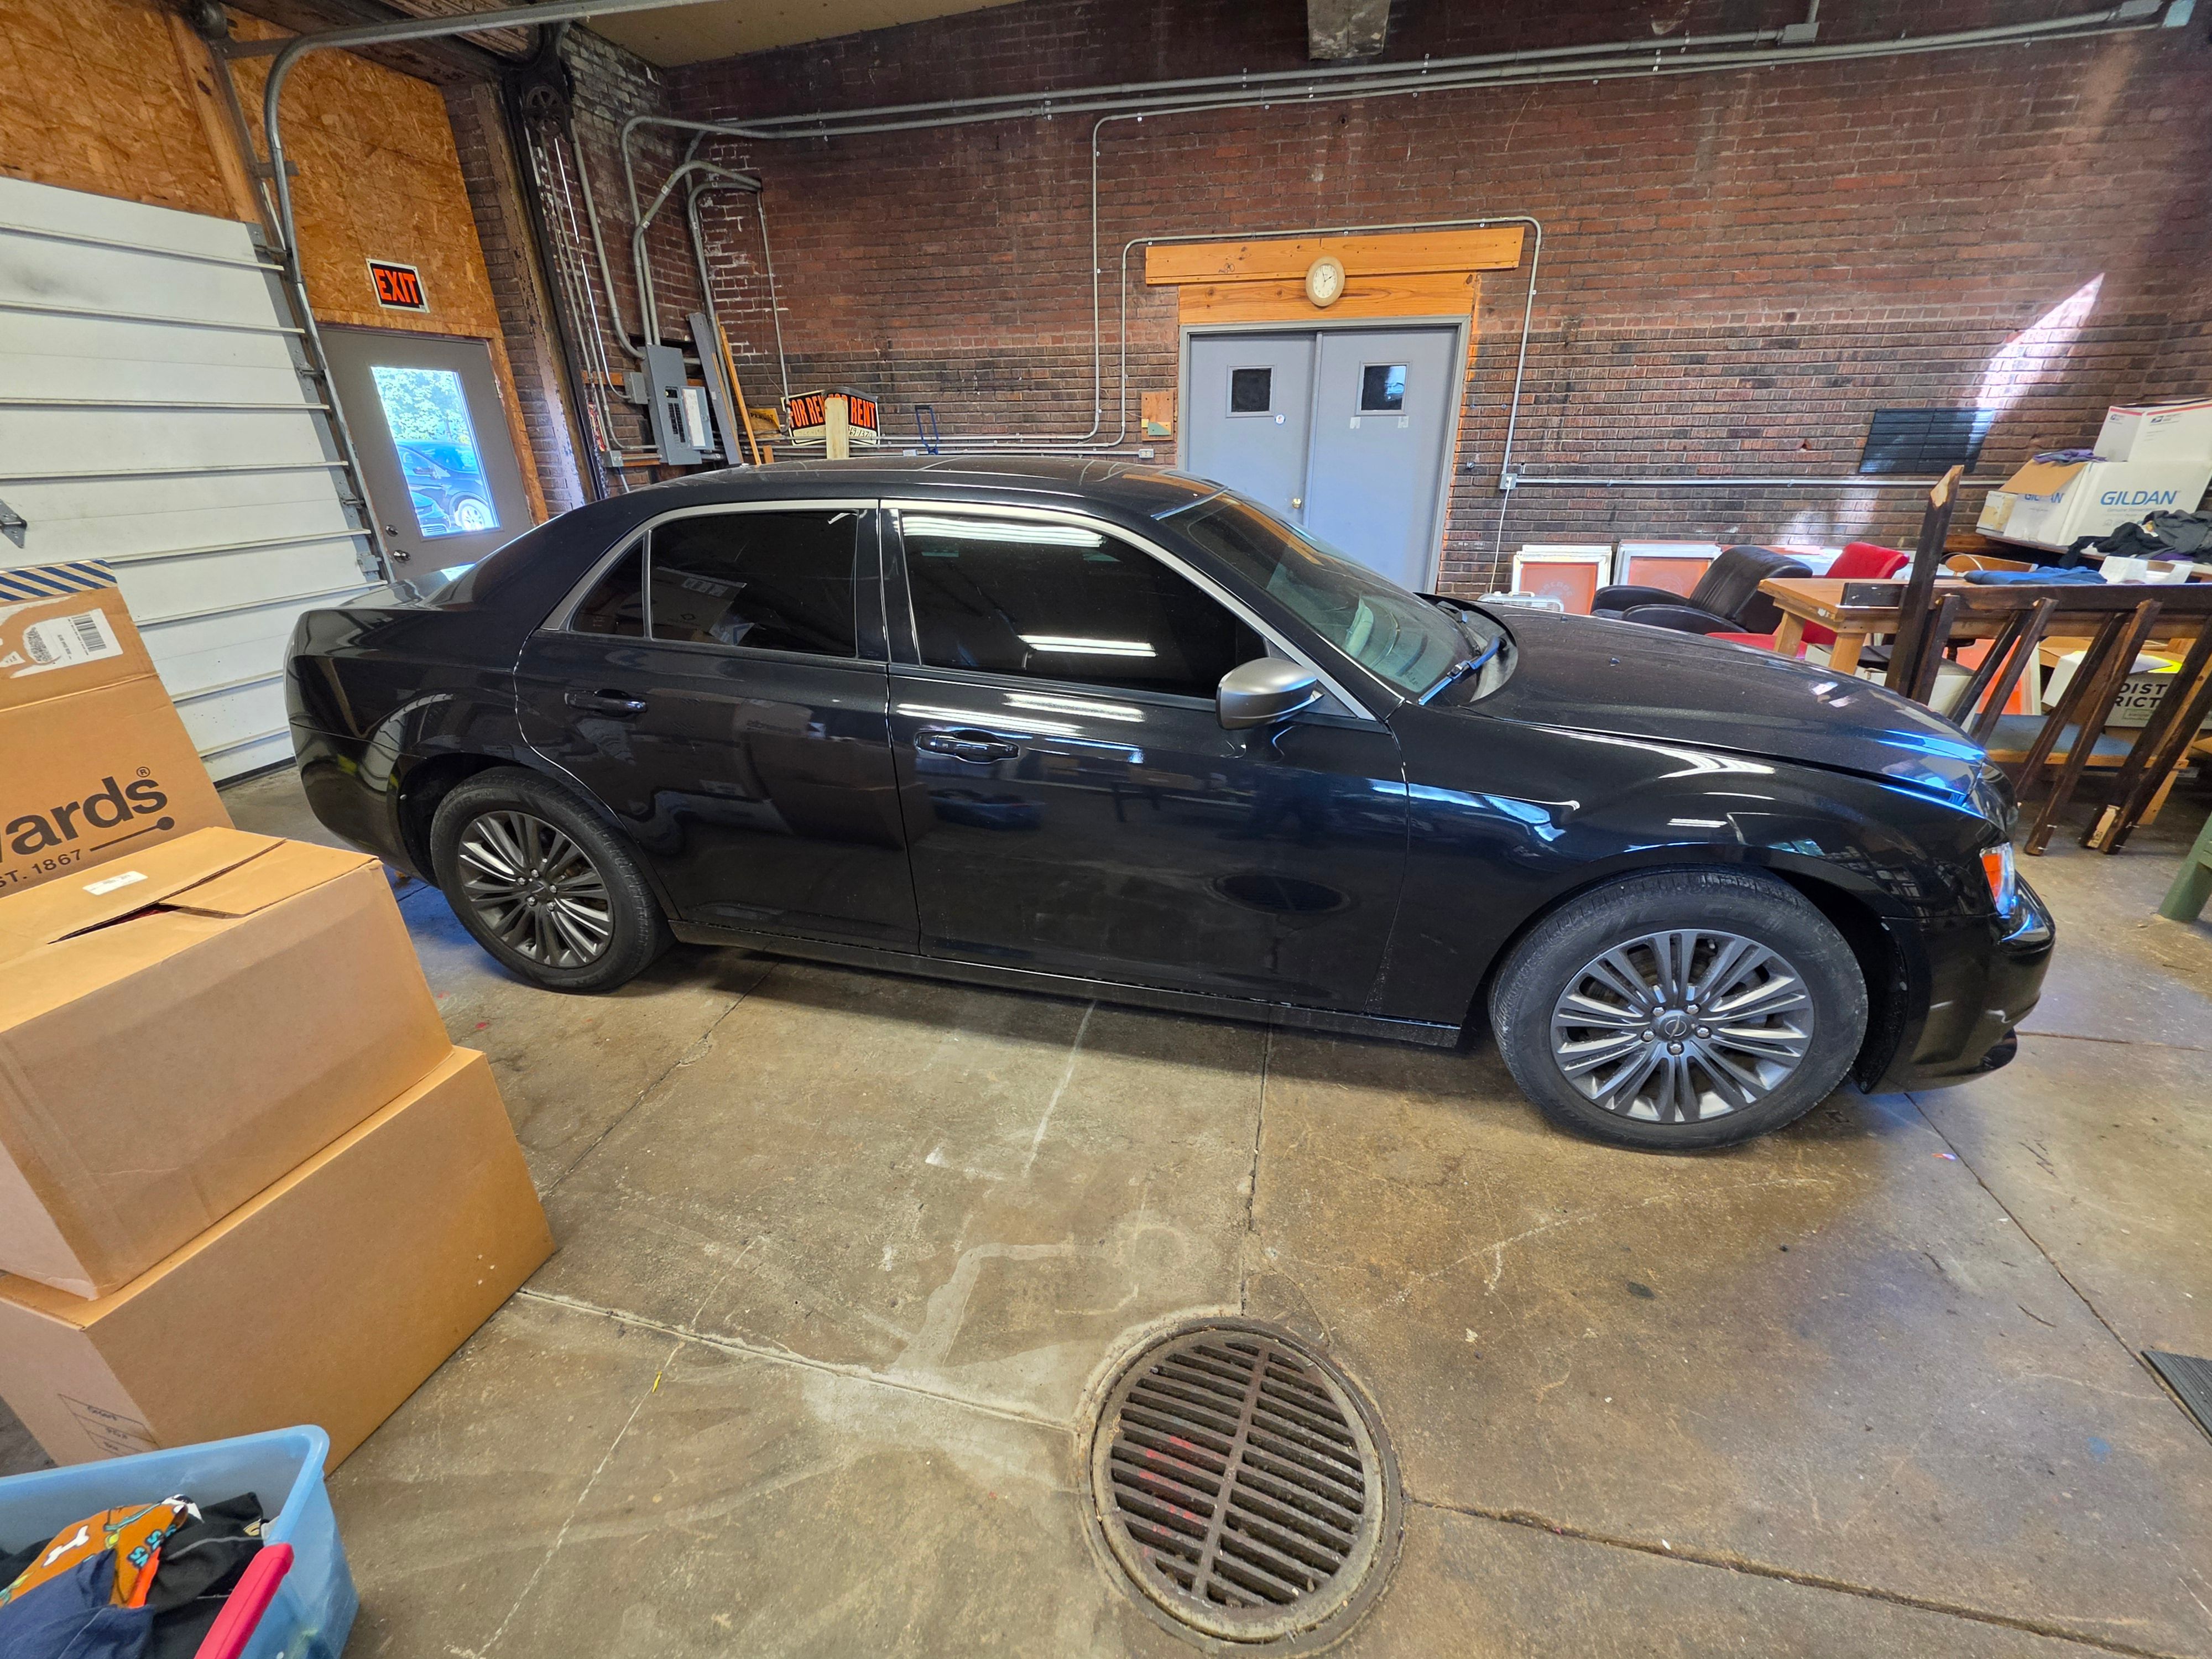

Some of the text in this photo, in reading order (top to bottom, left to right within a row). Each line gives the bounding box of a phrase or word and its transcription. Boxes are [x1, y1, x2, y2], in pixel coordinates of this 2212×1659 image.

[373, 268, 419, 304] EXIT
[851, 397, 875, 429] RENT
[2100, 491, 2177, 505] GILDAN
[2120, 683, 2168, 695] DIST
[2115, 696, 2161, 708] RICT
[0, 776, 168, 863] ards
[32, 849, 81, 874] 1867
